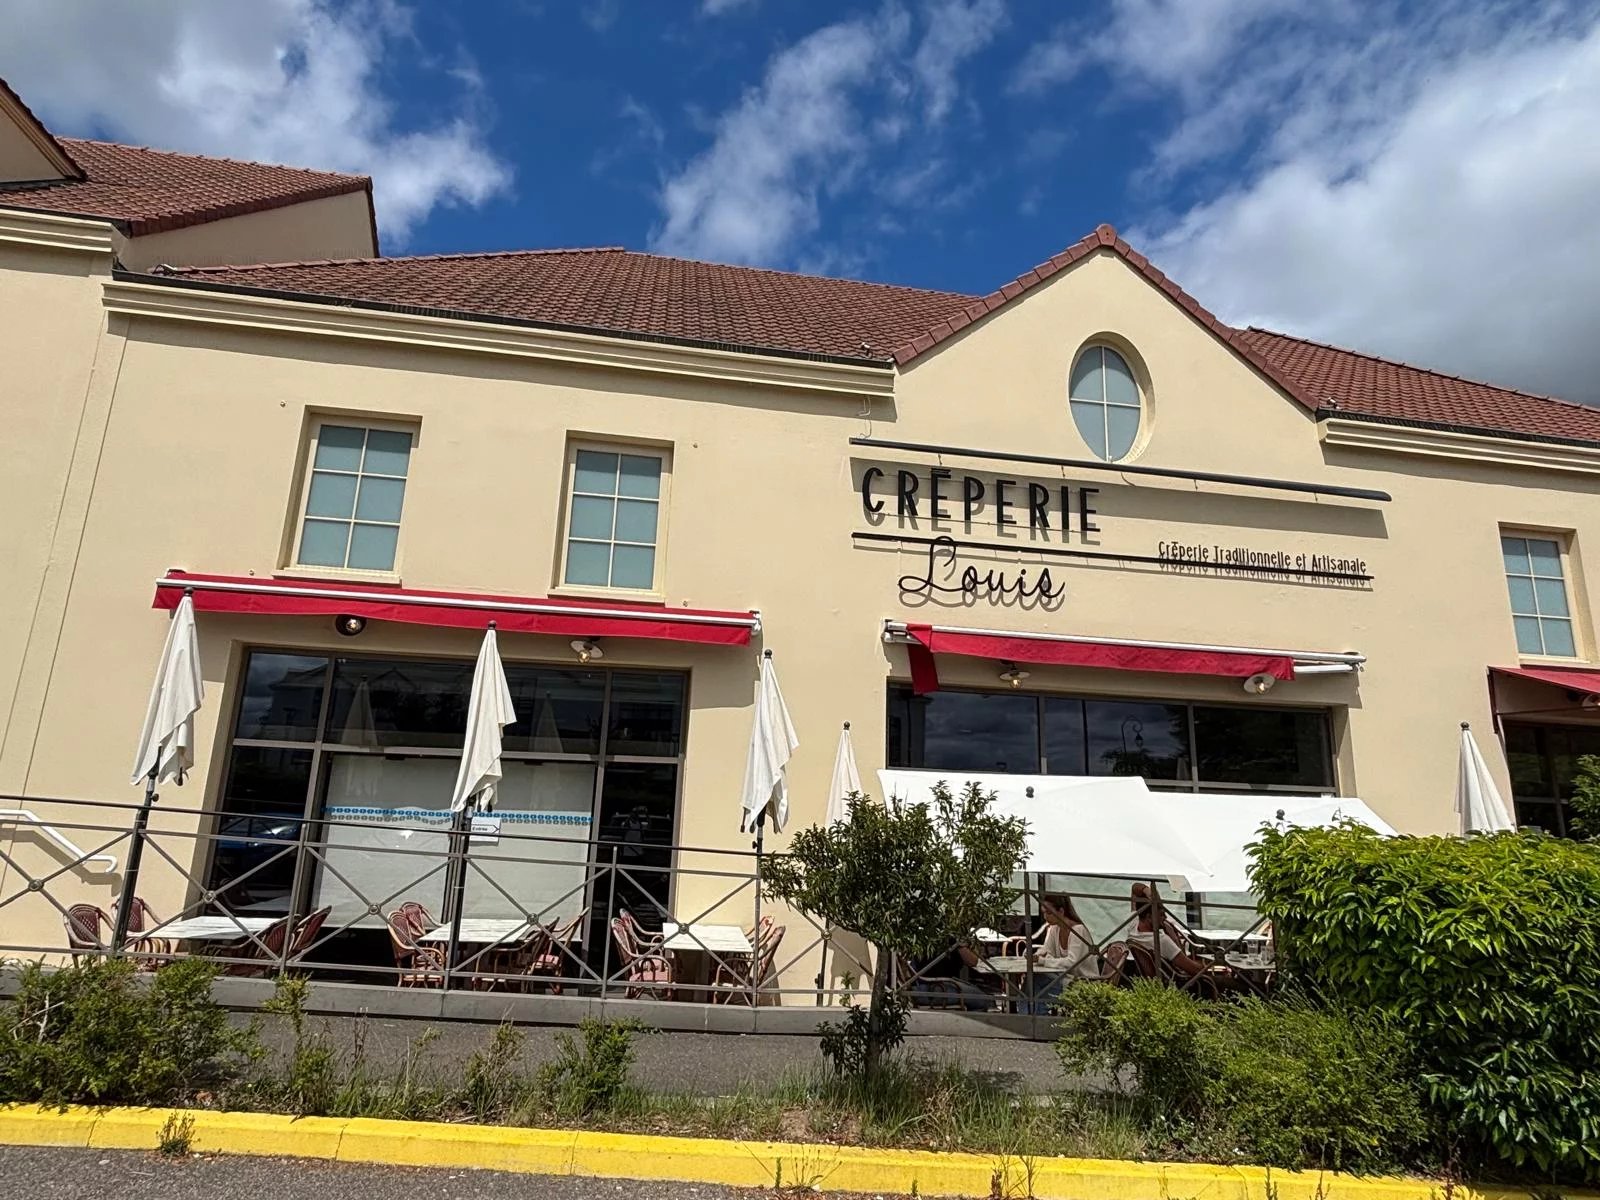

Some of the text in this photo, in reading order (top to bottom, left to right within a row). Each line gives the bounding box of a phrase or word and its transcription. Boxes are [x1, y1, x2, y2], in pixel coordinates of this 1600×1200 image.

[898, 535, 1066, 599] Louis
[1213, 545, 1291, 569] Traditionnelle
[1295, 553, 1306, 570] et
[1311, 554, 1366, 575] Artisanale
